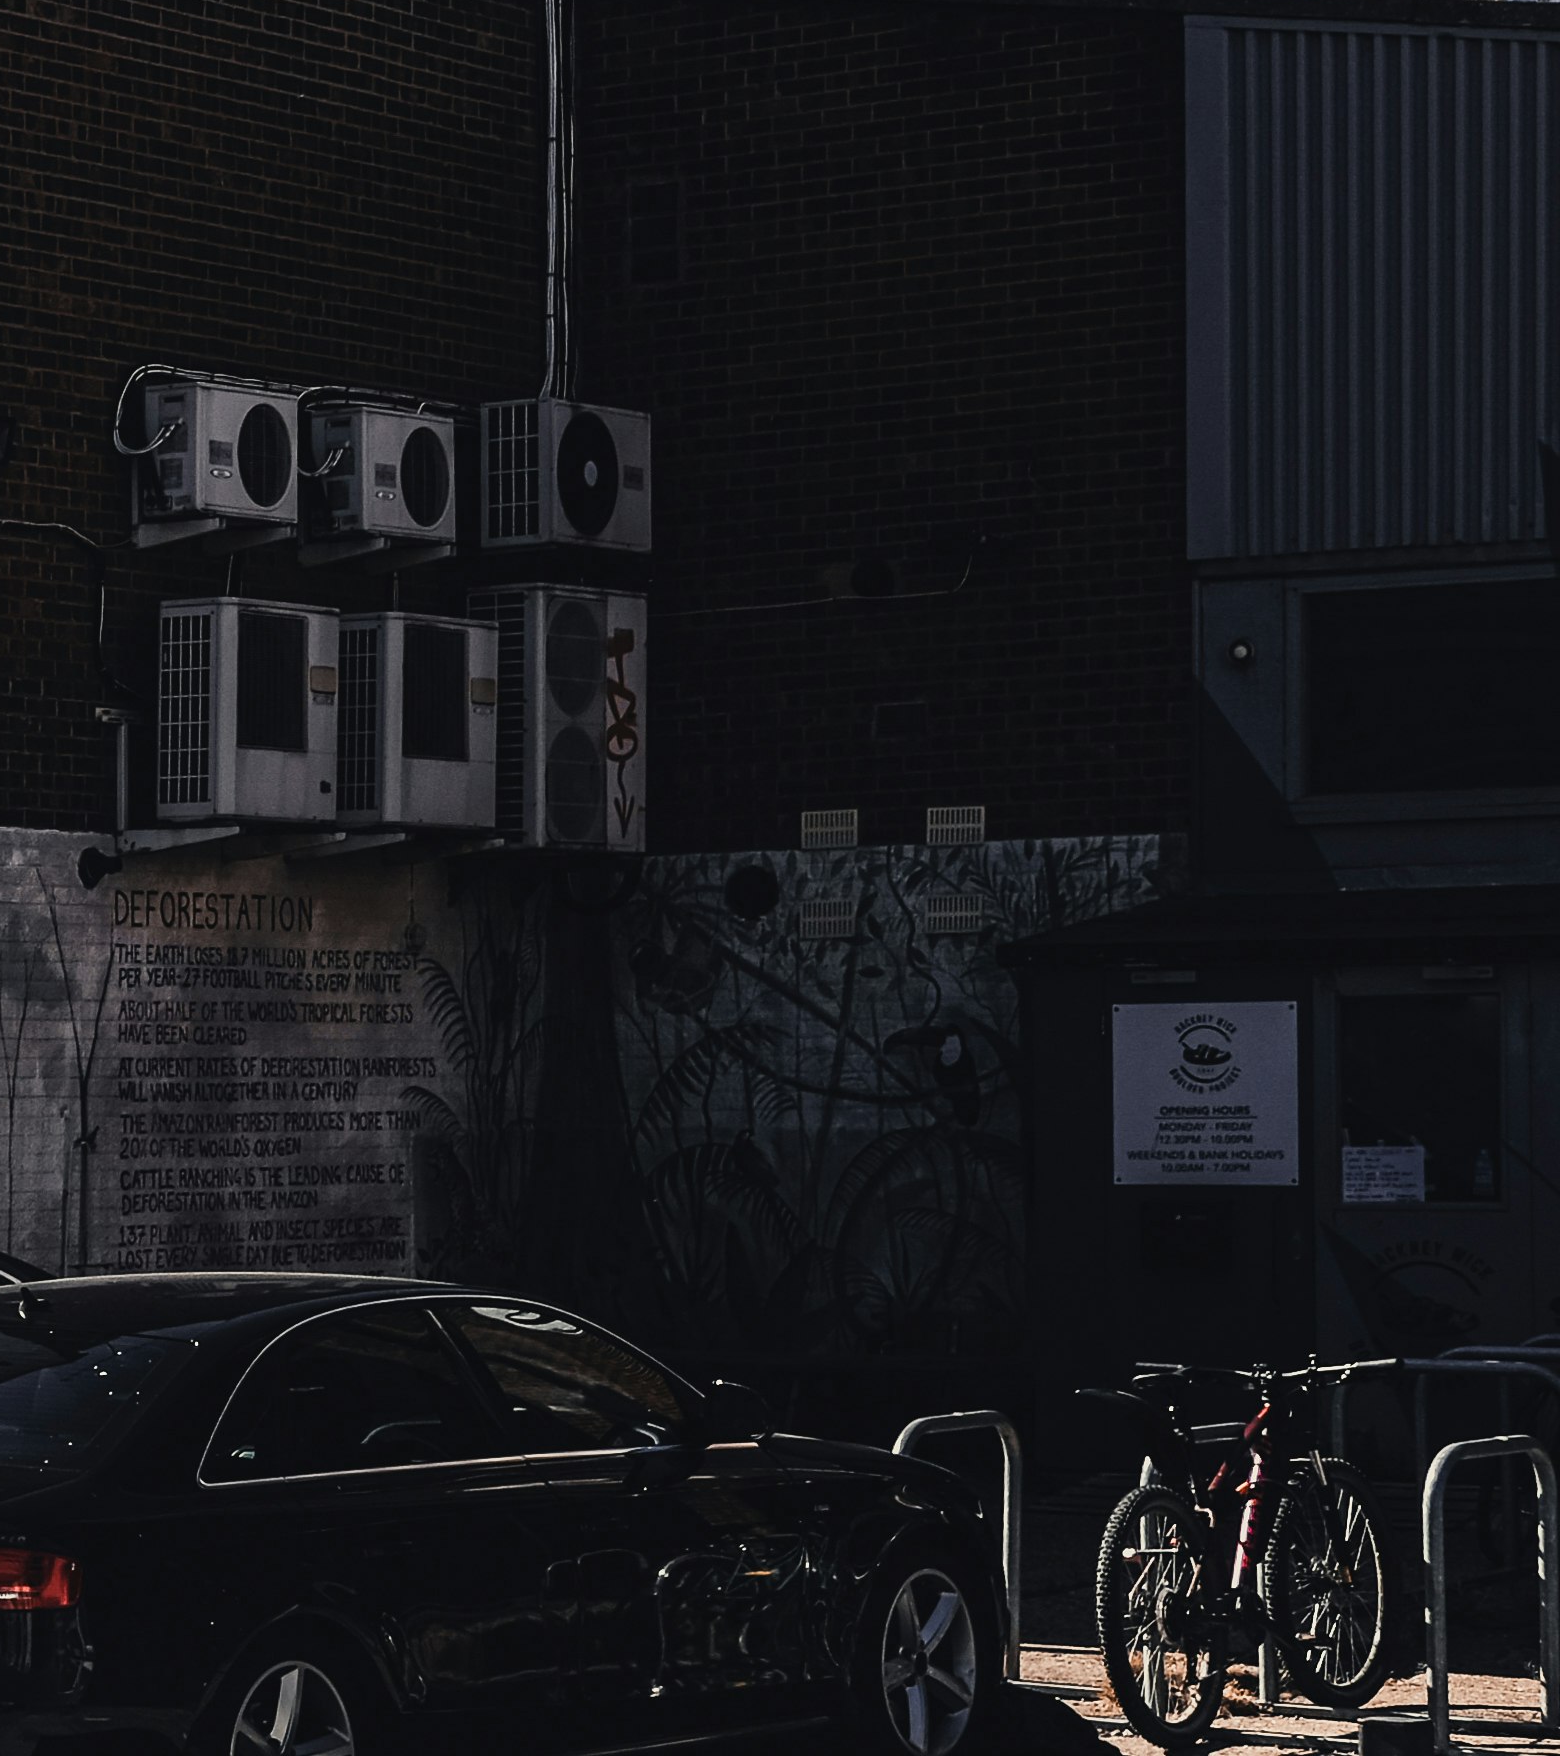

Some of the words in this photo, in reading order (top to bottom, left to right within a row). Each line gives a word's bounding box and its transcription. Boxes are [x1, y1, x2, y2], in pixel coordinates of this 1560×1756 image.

[115, 890, 313, 932] DEFORESTATION
[116, 944, 141, 964] THE
[146, 944, 184, 964] EARTH
[188, 946, 222, 965] LOSES
[252, 949, 306, 968] MILLION
[312, 951, 350, 970] ACRES
[354, 951, 370, 969] OF
[374, 951, 419, 970] FOREST
[119, 968, 140, 988] PER
[203, 970, 261, 990] FOOTBALL
[265, 972, 313, 991] PITCHES
[316, 974, 351, 991] EVERY
[355, 974, 401, 993] MINUTE
[119, 1001, 161, 1020] ABOUT
[165, 1001, 196, 1020] HALF
[202, 1002, 217, 1020] OF
[223, 1002, 245, 1021] THE
[248, 1000, 297, 1022] WORLD'S
[301, 1004, 357, 1022] TROPICAL
[360, 1004, 413, 1023] FORESTS
[118, 1025, 150, 1044] HAVE
[156, 1025, 188, 1044] BEEN
[193, 1026, 247, 1045] CLEARED
[119, 1058, 135, 1077] AT
[136, 1058, 192, 1077] CURRENT
[197, 1058, 237, 1077] RATES
[240, 1058, 259, 1076] OF
[261, 1058, 360, 1077] DEFORESTATION
[363, 1058, 436, 1077] RAINFORESTS
[119, 1082, 148, 1102] WILL
[150, 1082, 192, 1102] VANISH
[195, 1082, 269, 1102] ALTOGETHER
[273, 1082, 286, 1100] IN
[291, 1082, 298, 1099] A
[301, 1082, 358, 1100] CENTURY
[1160, 1106, 1209, 1115] OPENING
[1212, 1106, 1250, 1114] HOURS
[121, 1114, 146, 1134] THE
[151, 1114, 204, 1133] AMAZON
[204, 1112, 278, 1132] RAINFOREST
[284, 1112, 344, 1131] PRODUCES
[350, 1111, 382, 1131] MORE
[386, 1111, 421, 1129] THAN
[1159, 1123, 1205, 1131] MONDAY
[1216, 1123, 1252, 1131] FRIDAY
[120, 1139, 148, 1158] 20%
[150, 1139, 165, 1157] OF
[167, 1139, 194, 1157] THE
[254, 1138, 301, 1157] OXYGEN
[1128, 1151, 1185, 1160] WEEKENDS
[1188, 1151, 1195, 1159] &
[1199, 1151, 1227, 1159] BANK
[1231, 1151, 1284, 1159] HOLIDAYS
[120, 1170, 174, 1190] CATTLE
[180, 1169, 241, 1188] RANCHING
[245, 1169, 255, 1186] IS
[260, 1168, 284, 1186] THE
[288, 1165, 341, 1186] LEADING
[346, 1164, 384, 1184] CAUSE
[122, 1192, 225, 1214] DEFORESTATION
[229, 1192, 241, 1209] IN
[242, 1192, 265, 1208] THE
[271, 1191, 318, 1209] AMAZON
[119, 1226, 146, 1246] 137
[198, 1224, 241, 1243] ANIMAL
[249, 1222, 273, 1240] AND
[277, 1220, 319, 1239] INSECT
[323, 1219, 374, 1237] SPECIES
[380, 1218, 404, 1236] ARE
[118, 1250, 152, 1269] LOST
[156, 1247, 196, 1268] EVERY
[247, 1246, 270, 1266] DAY
[272, 1246, 293, 1265] DUE
[311, 1241, 405, 1262] DEFORESTATION
